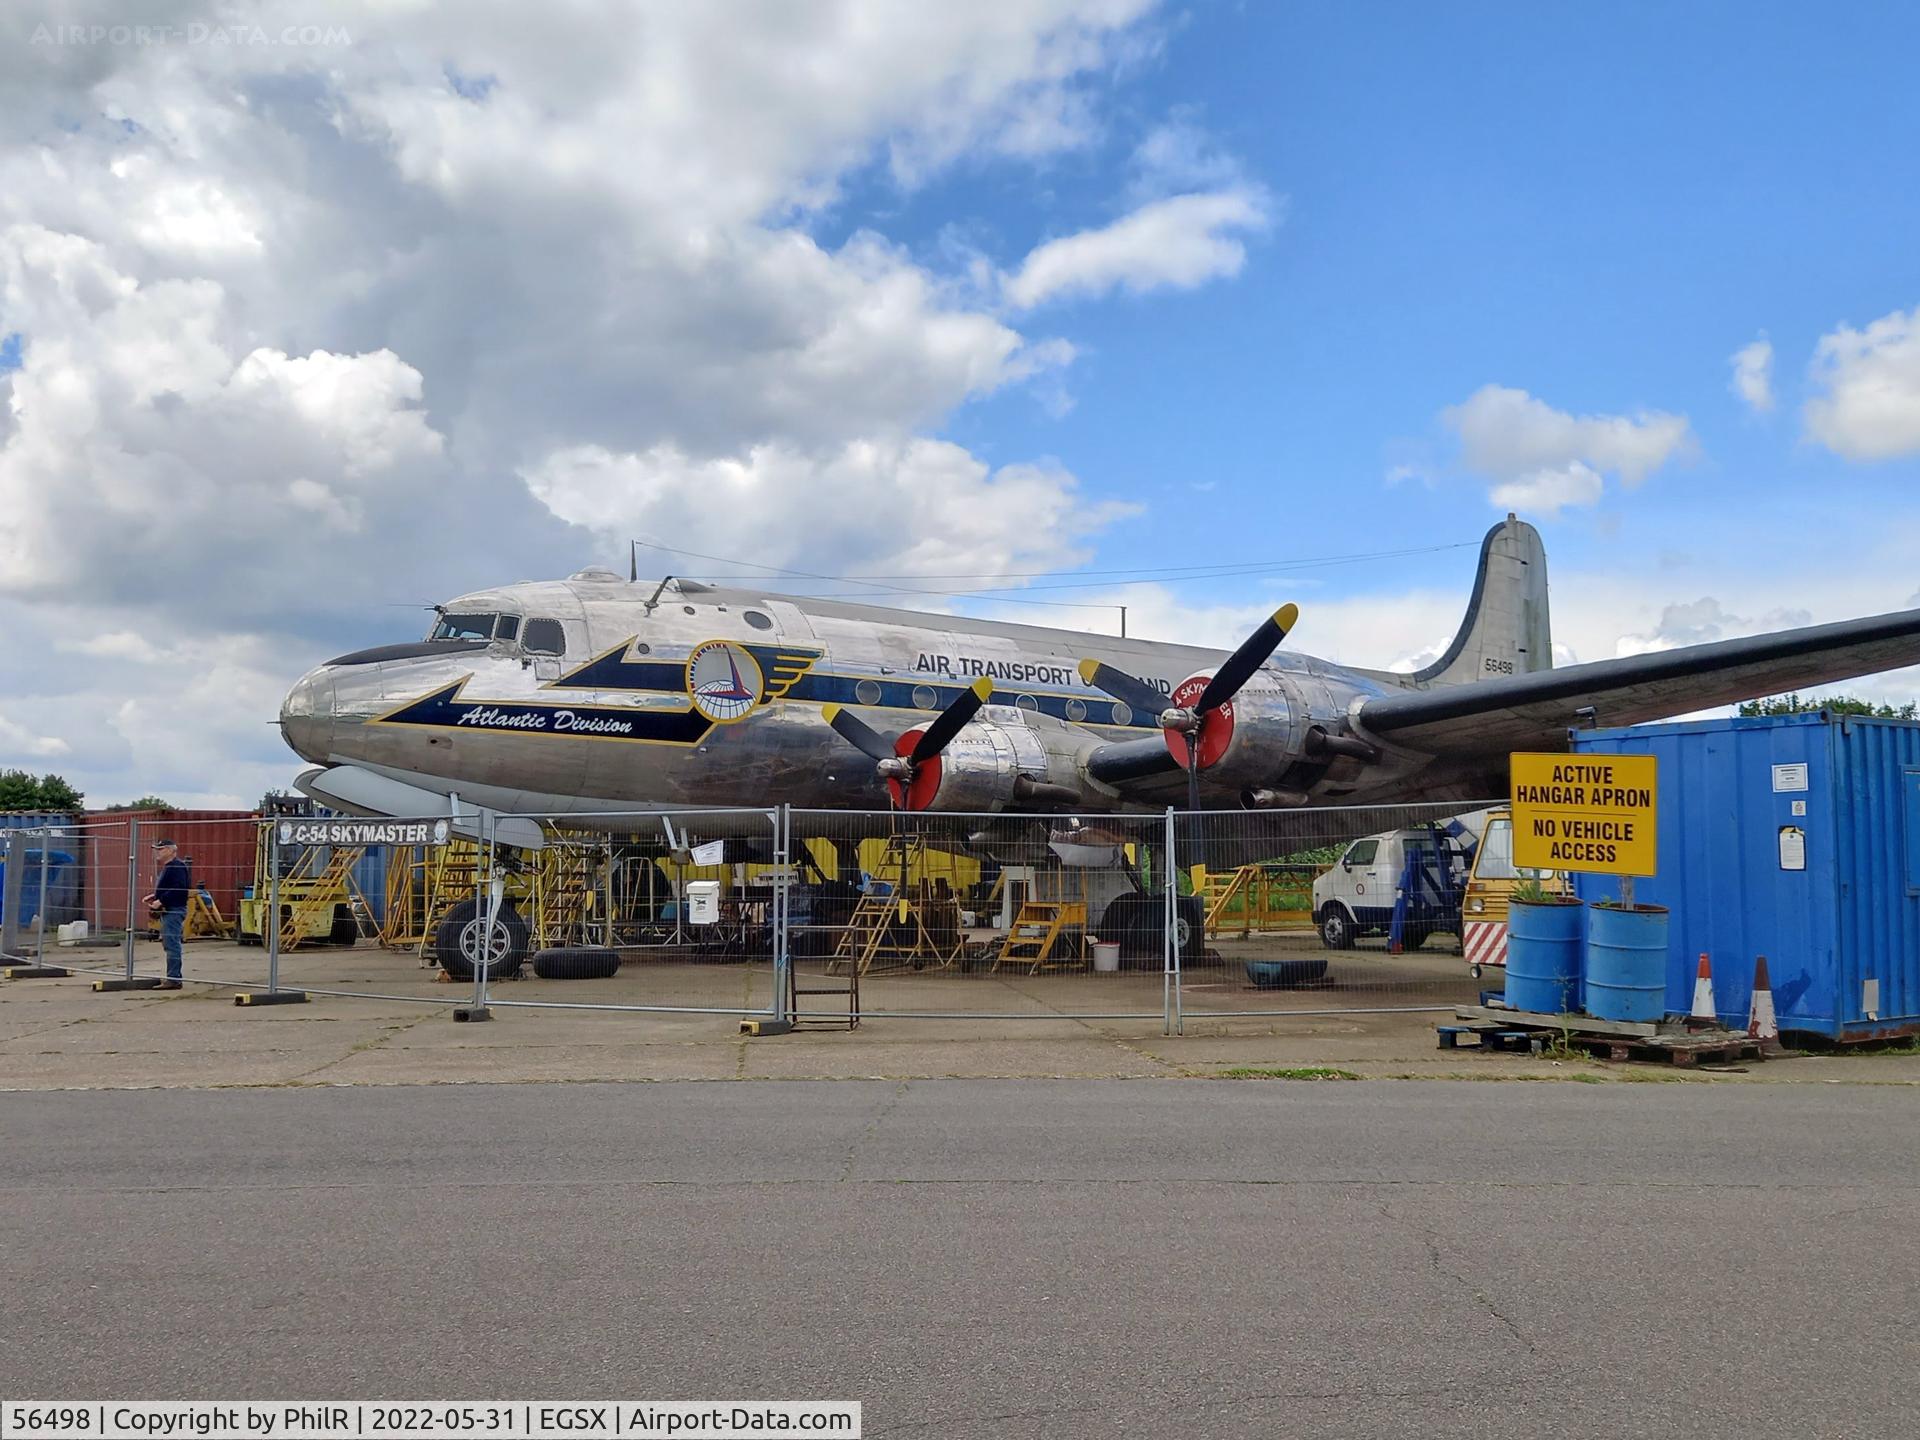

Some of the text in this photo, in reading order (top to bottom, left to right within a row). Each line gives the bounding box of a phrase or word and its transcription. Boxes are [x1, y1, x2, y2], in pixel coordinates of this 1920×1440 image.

[916, 653, 950, 674] AIR
[959, 656, 1073, 686] TRANSPORT
[457, 705, 633, 734] Atlantic Division
[1552, 765, 1613, 784] ACTIVE
[1517, 785, 1651, 807] HANGAR APRON
[295, 824, 428, 842] C-54 SKYMASTER
[1533, 819, 1634, 841] NO VEHICLE
[1551, 842, 1616, 862] ACCESS
